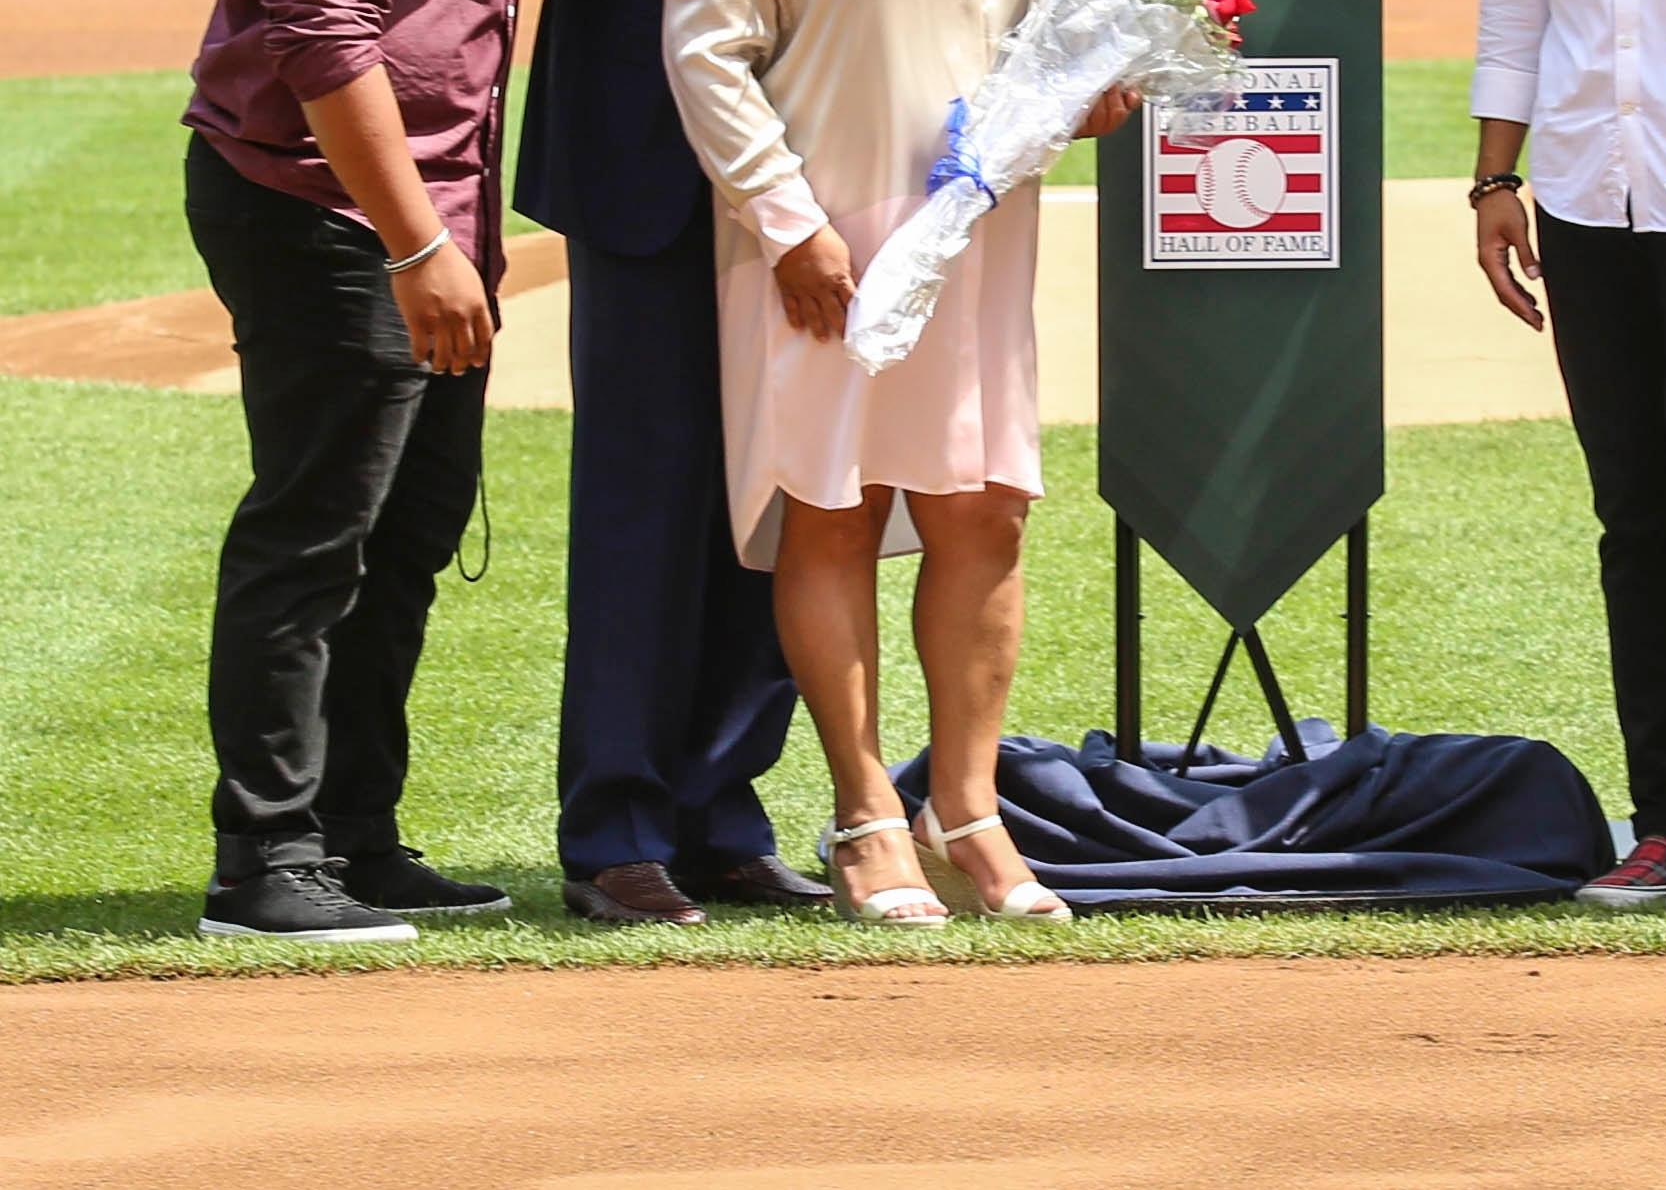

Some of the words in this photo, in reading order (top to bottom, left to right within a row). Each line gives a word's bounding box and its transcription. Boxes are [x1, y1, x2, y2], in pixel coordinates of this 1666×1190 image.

[1241, 72, 1323, 89] ONAL
[1158, 114, 1323, 132] ASEBALL
[1159, 236, 1219, 252] HALL
[1225, 236, 1255, 252] OF
[1263, 235, 1323, 252] FAME
